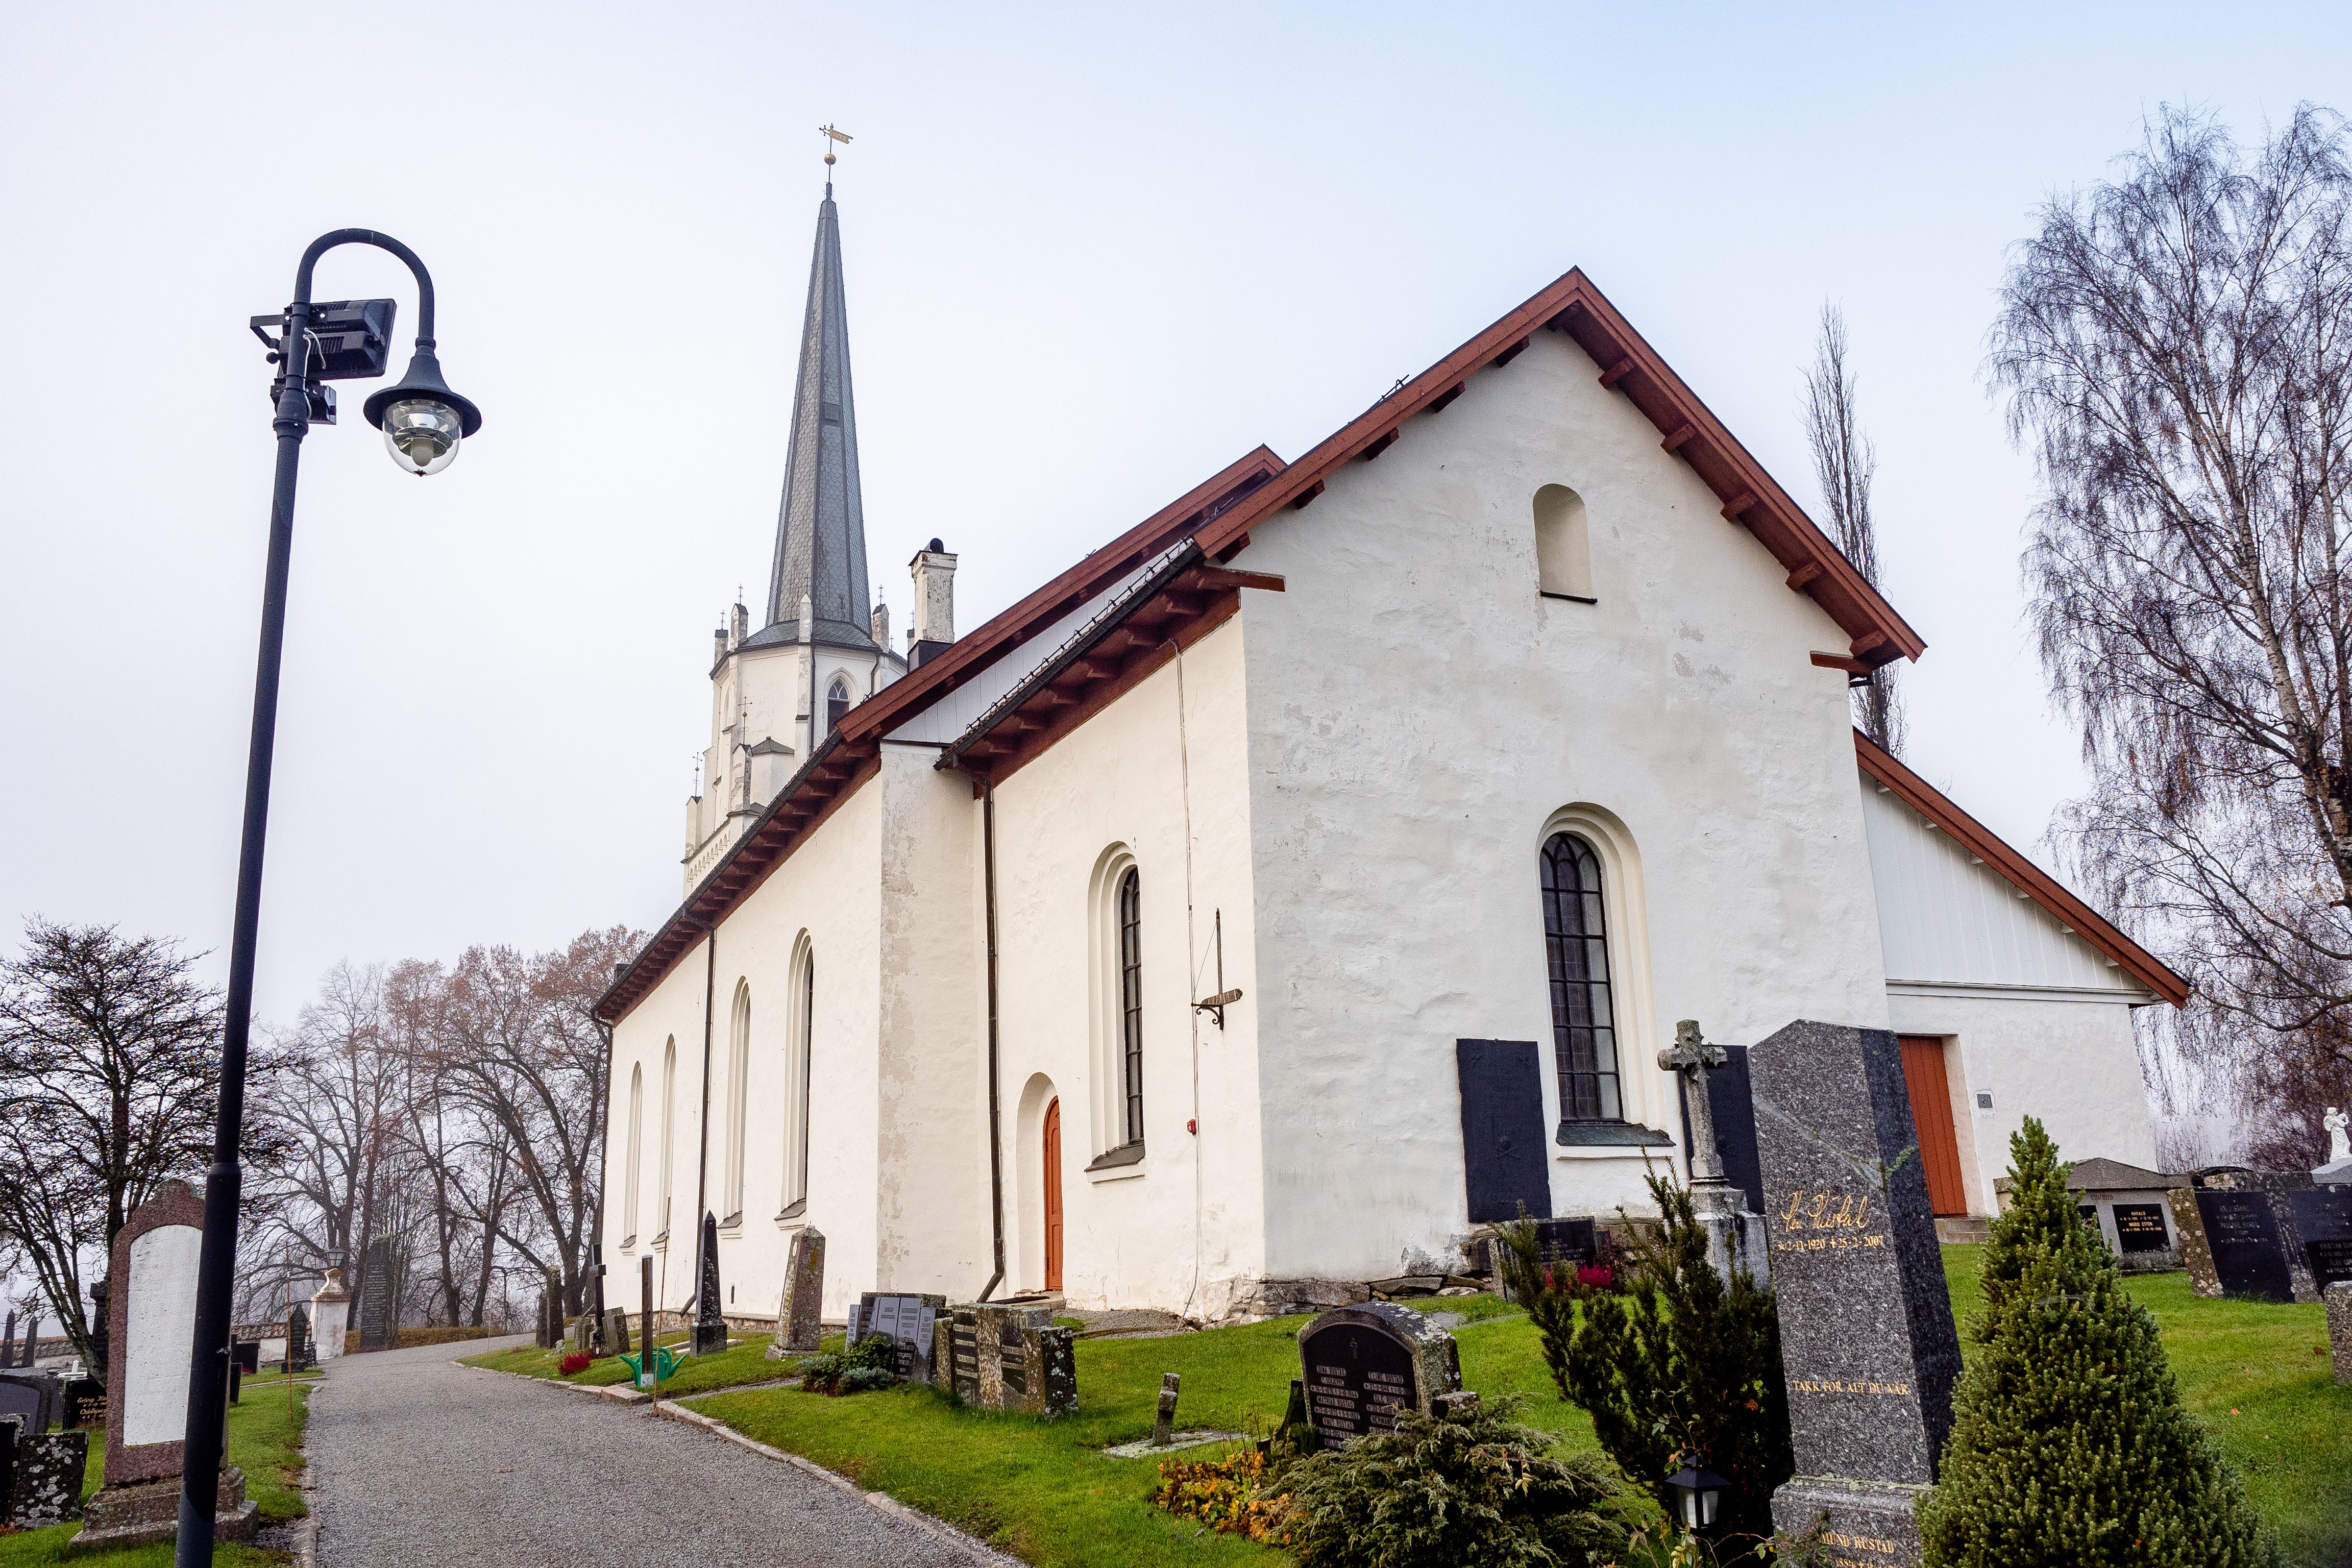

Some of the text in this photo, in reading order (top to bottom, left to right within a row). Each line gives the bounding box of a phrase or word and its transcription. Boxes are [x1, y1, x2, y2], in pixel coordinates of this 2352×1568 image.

[1793, 1380, 1909, 1394] TAKK FOR ALT DU VAR
[1853, 1536, 1894, 1553] RUSTAD
